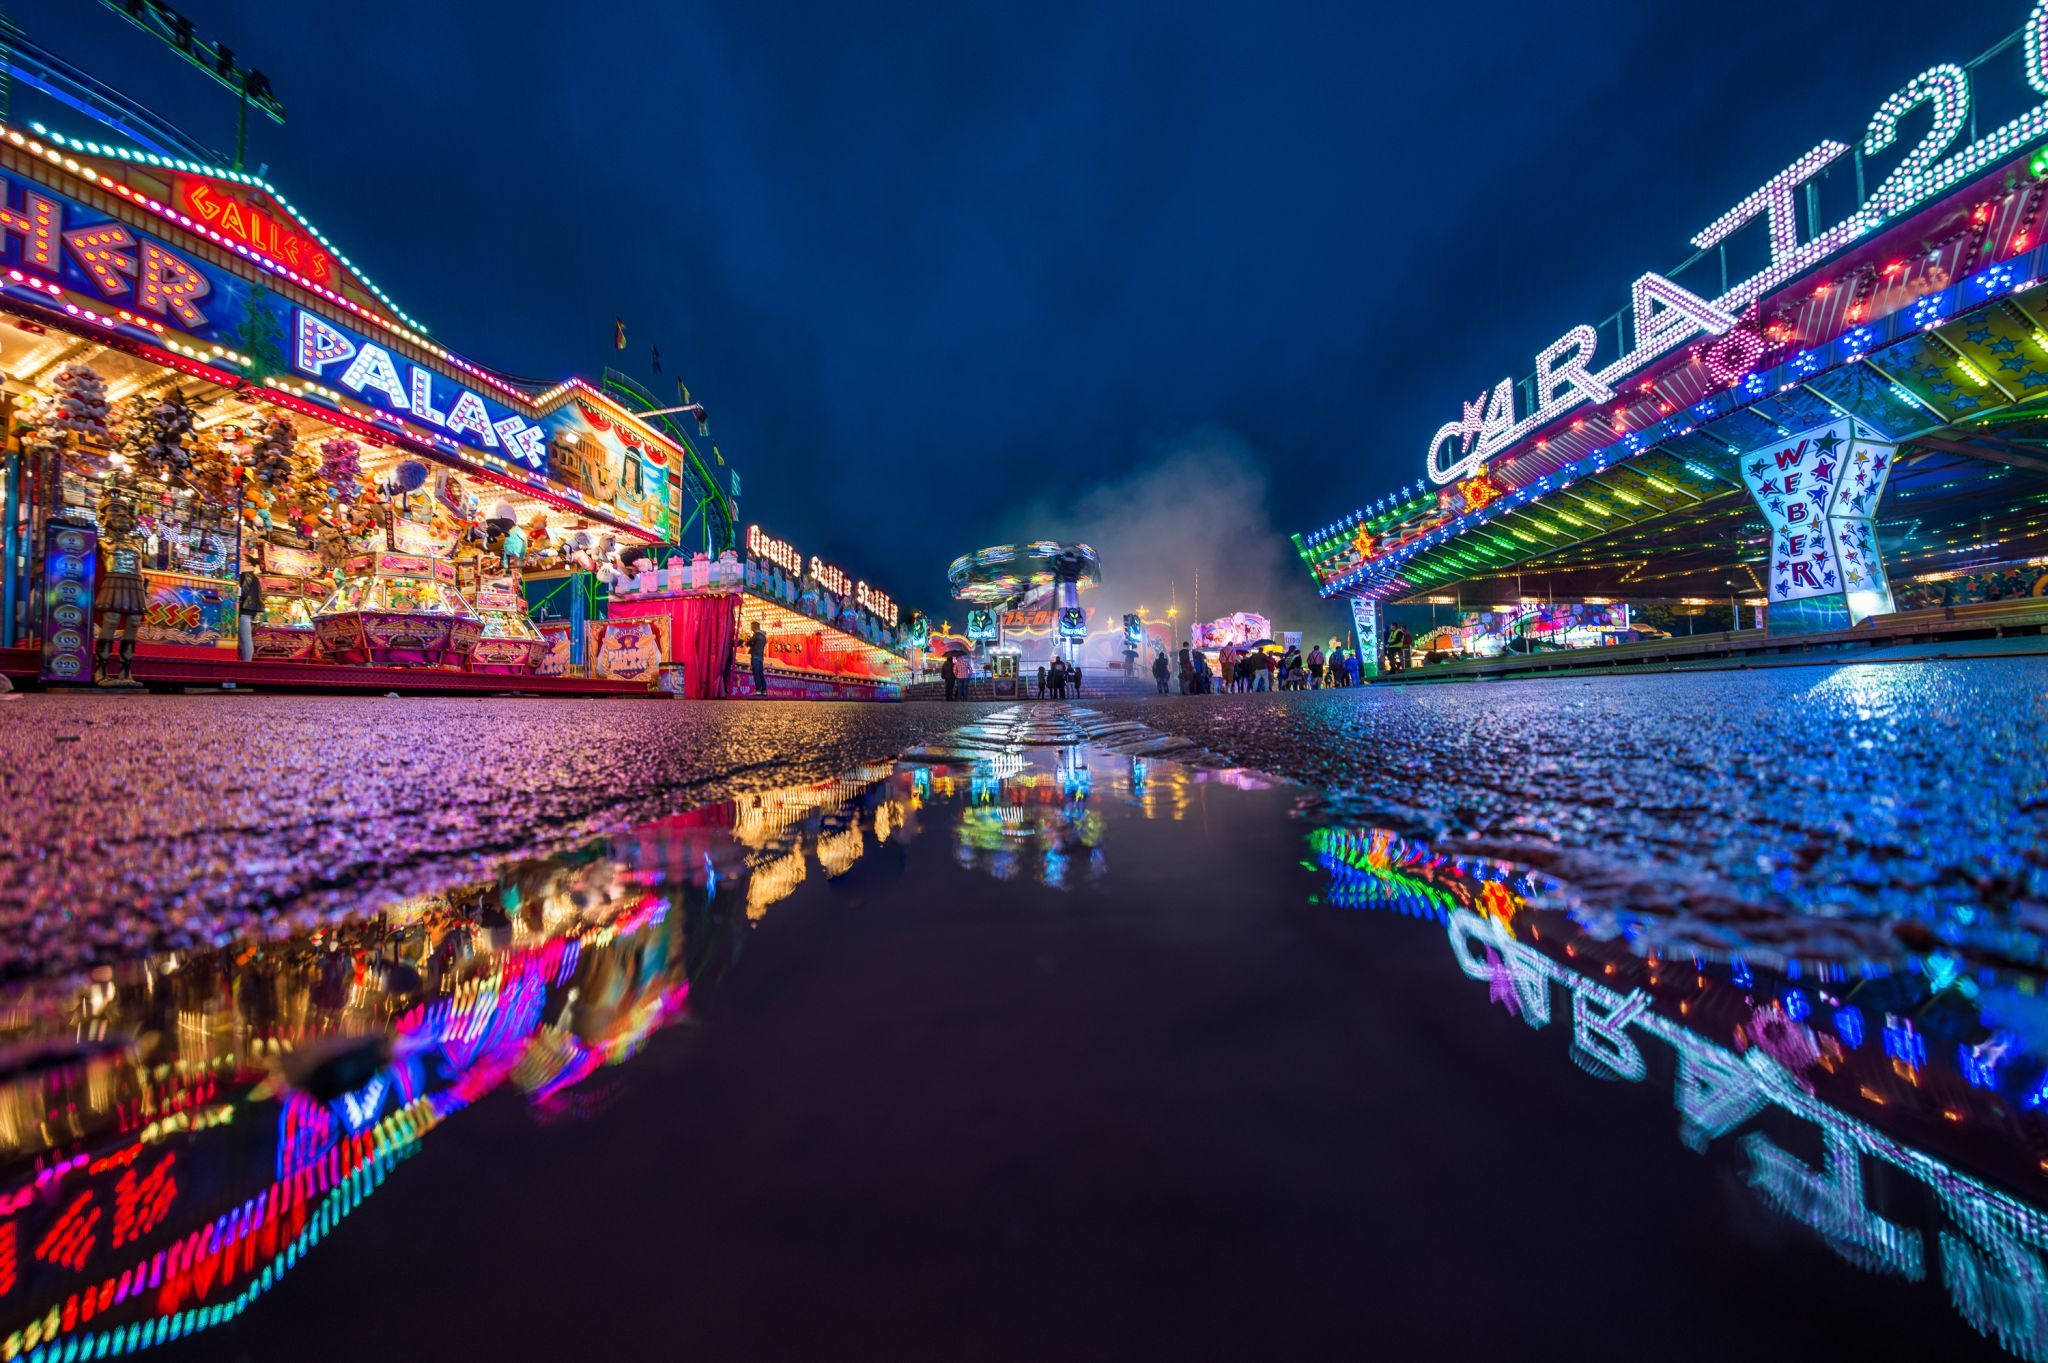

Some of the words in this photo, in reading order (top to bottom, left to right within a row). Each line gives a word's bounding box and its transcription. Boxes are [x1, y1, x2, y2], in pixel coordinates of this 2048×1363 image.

[191, 184, 327, 279] GALLE'S
[1427, 139, 1852, 484] CARAT
[297, 307, 548, 469] PALACE
[1774, 439, 1823, 591] WEBER
[61, 611, 75, 620] 40
[62, 586, 76, 595] 20
[55, 661, 78, 670] 220
